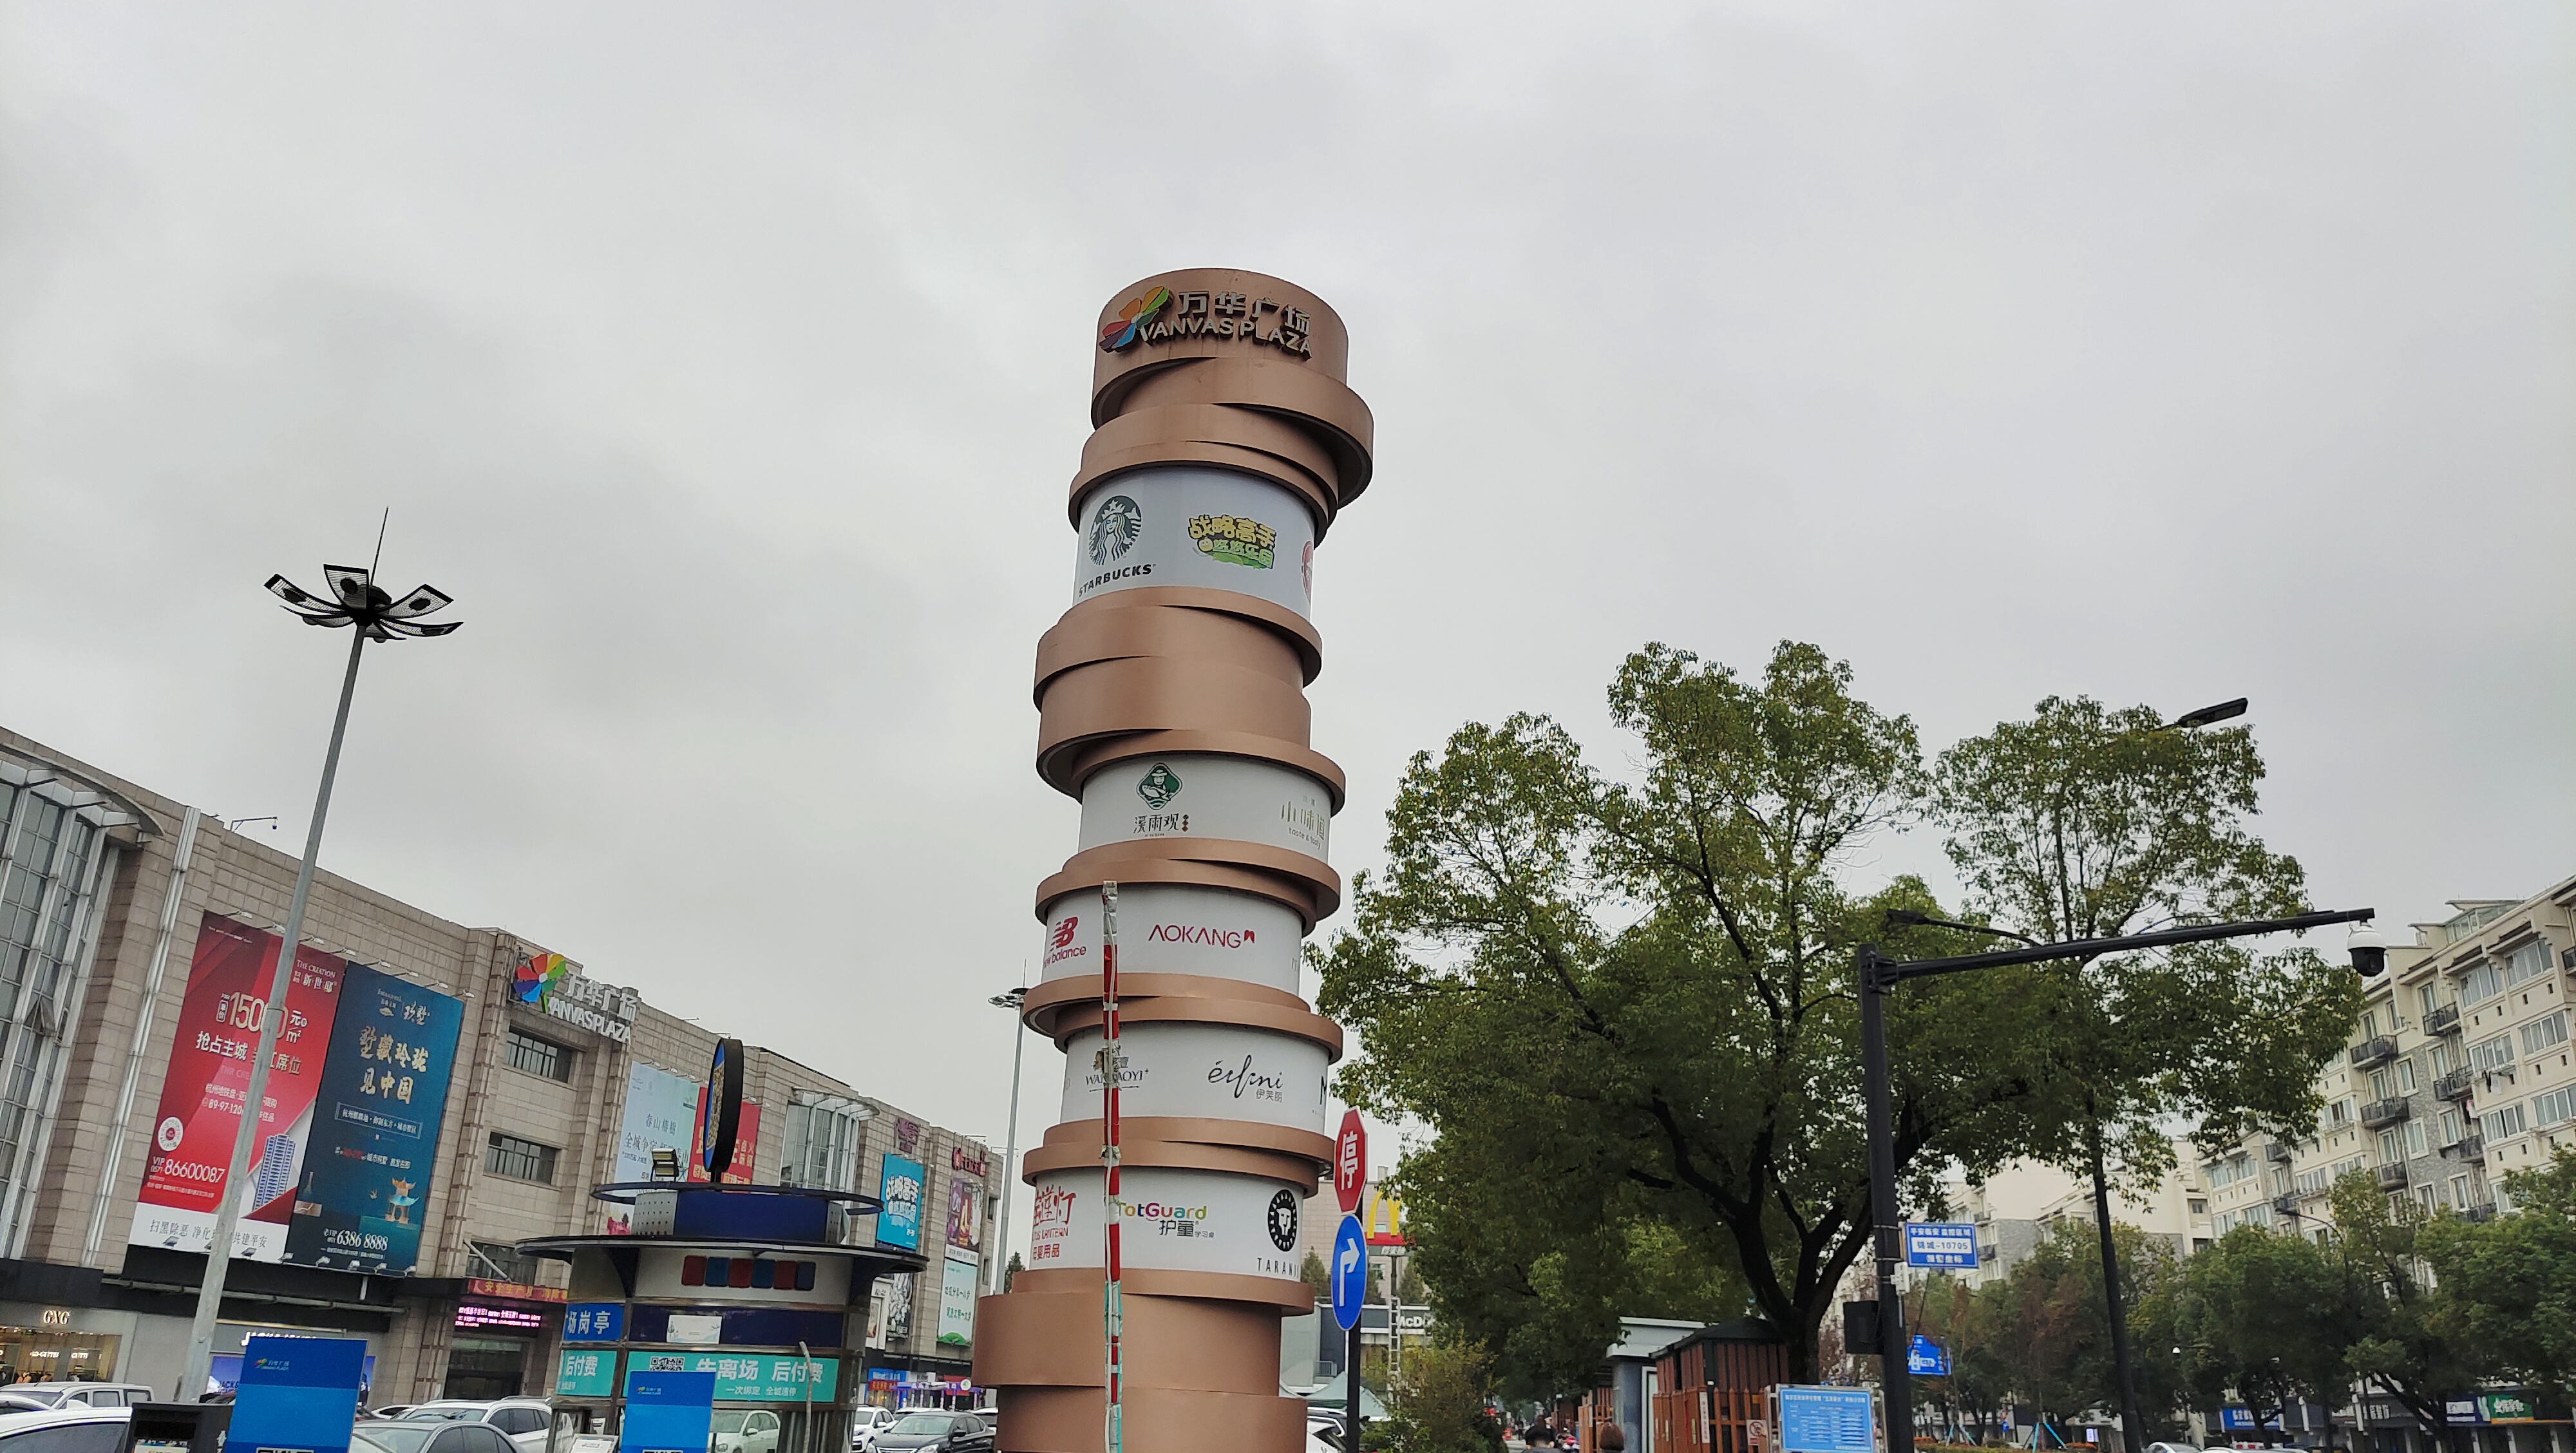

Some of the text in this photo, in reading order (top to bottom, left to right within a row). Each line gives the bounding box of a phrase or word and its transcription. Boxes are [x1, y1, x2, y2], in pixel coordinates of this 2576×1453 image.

[1178, 290, 1312, 336] 万华广场
[1139, 318, 1312, 359] VANVAS PLAZA
[1188, 514, 1276, 547] 战略高手
[1079, 564, 1152, 598] STARBUCKS
[1148, 924, 1241, 949] AOKANG
[1052, 946, 1086, 964] balance
[565, 971, 638, 1022] 万华广场
[549, 997, 630, 1045] VANVAS PLAZA
[196, 1030, 248, 1060] 抢占主城
[164, 1159, 225, 1183] 86600087
[1340, 1130, 1359, 1191] 停
[1119, 1202, 1207, 1220] TotGuard
[149, 1219, 189, 1237] 扫黑除恶
[232, 1231, 268, 1248] 共建平安
[337, 1230, 362, 1248] 6386
[363, 1233, 389, 1251] 8888
[1042, 1227, 1068, 1240] LANTERN
[1159, 1220, 1195, 1237] 护童
[43, 1309, 70, 1325] GXG
[565, 1310, 611, 1335] 场岗亭
[565, 1355, 598, 1377] 后付费
[772, 1361, 823, 1383] 后付费
[726, 1385, 760, 1396] 一次绑定
